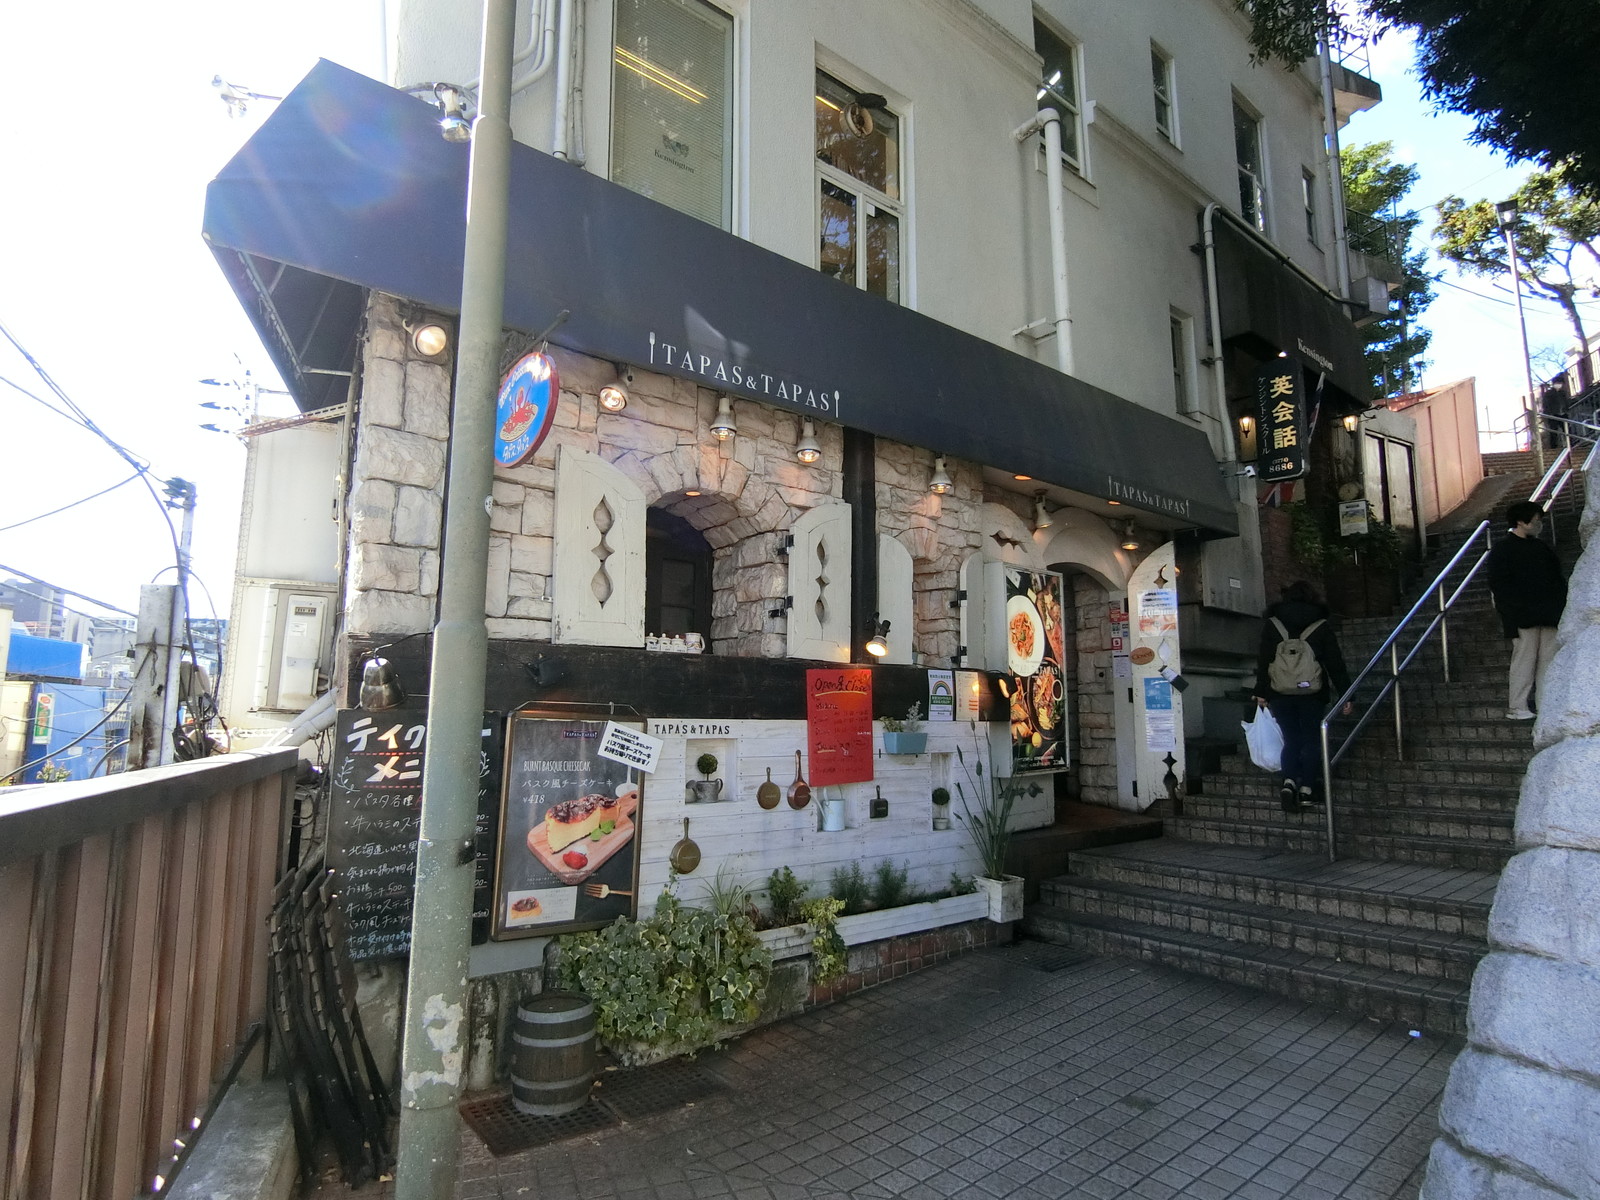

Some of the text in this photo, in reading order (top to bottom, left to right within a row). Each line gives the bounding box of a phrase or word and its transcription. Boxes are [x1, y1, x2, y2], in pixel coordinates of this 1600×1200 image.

[654, 149, 694, 174] Kensington
[1297, 337, 1333, 371] Kensington
[662, 343, 830, 412] TAPAS&TAPAS
[1269, 374, 1298, 450] 英会話
[1268, 461, 1294, 473] 8686
[1113, 481, 1185, 515] TAPAS&TAPAS
[654, 724, 730, 735] TAPAS&TAPAS
[523, 760, 541, 772] BURNT
[542, 760, 563, 774] BASQUE
